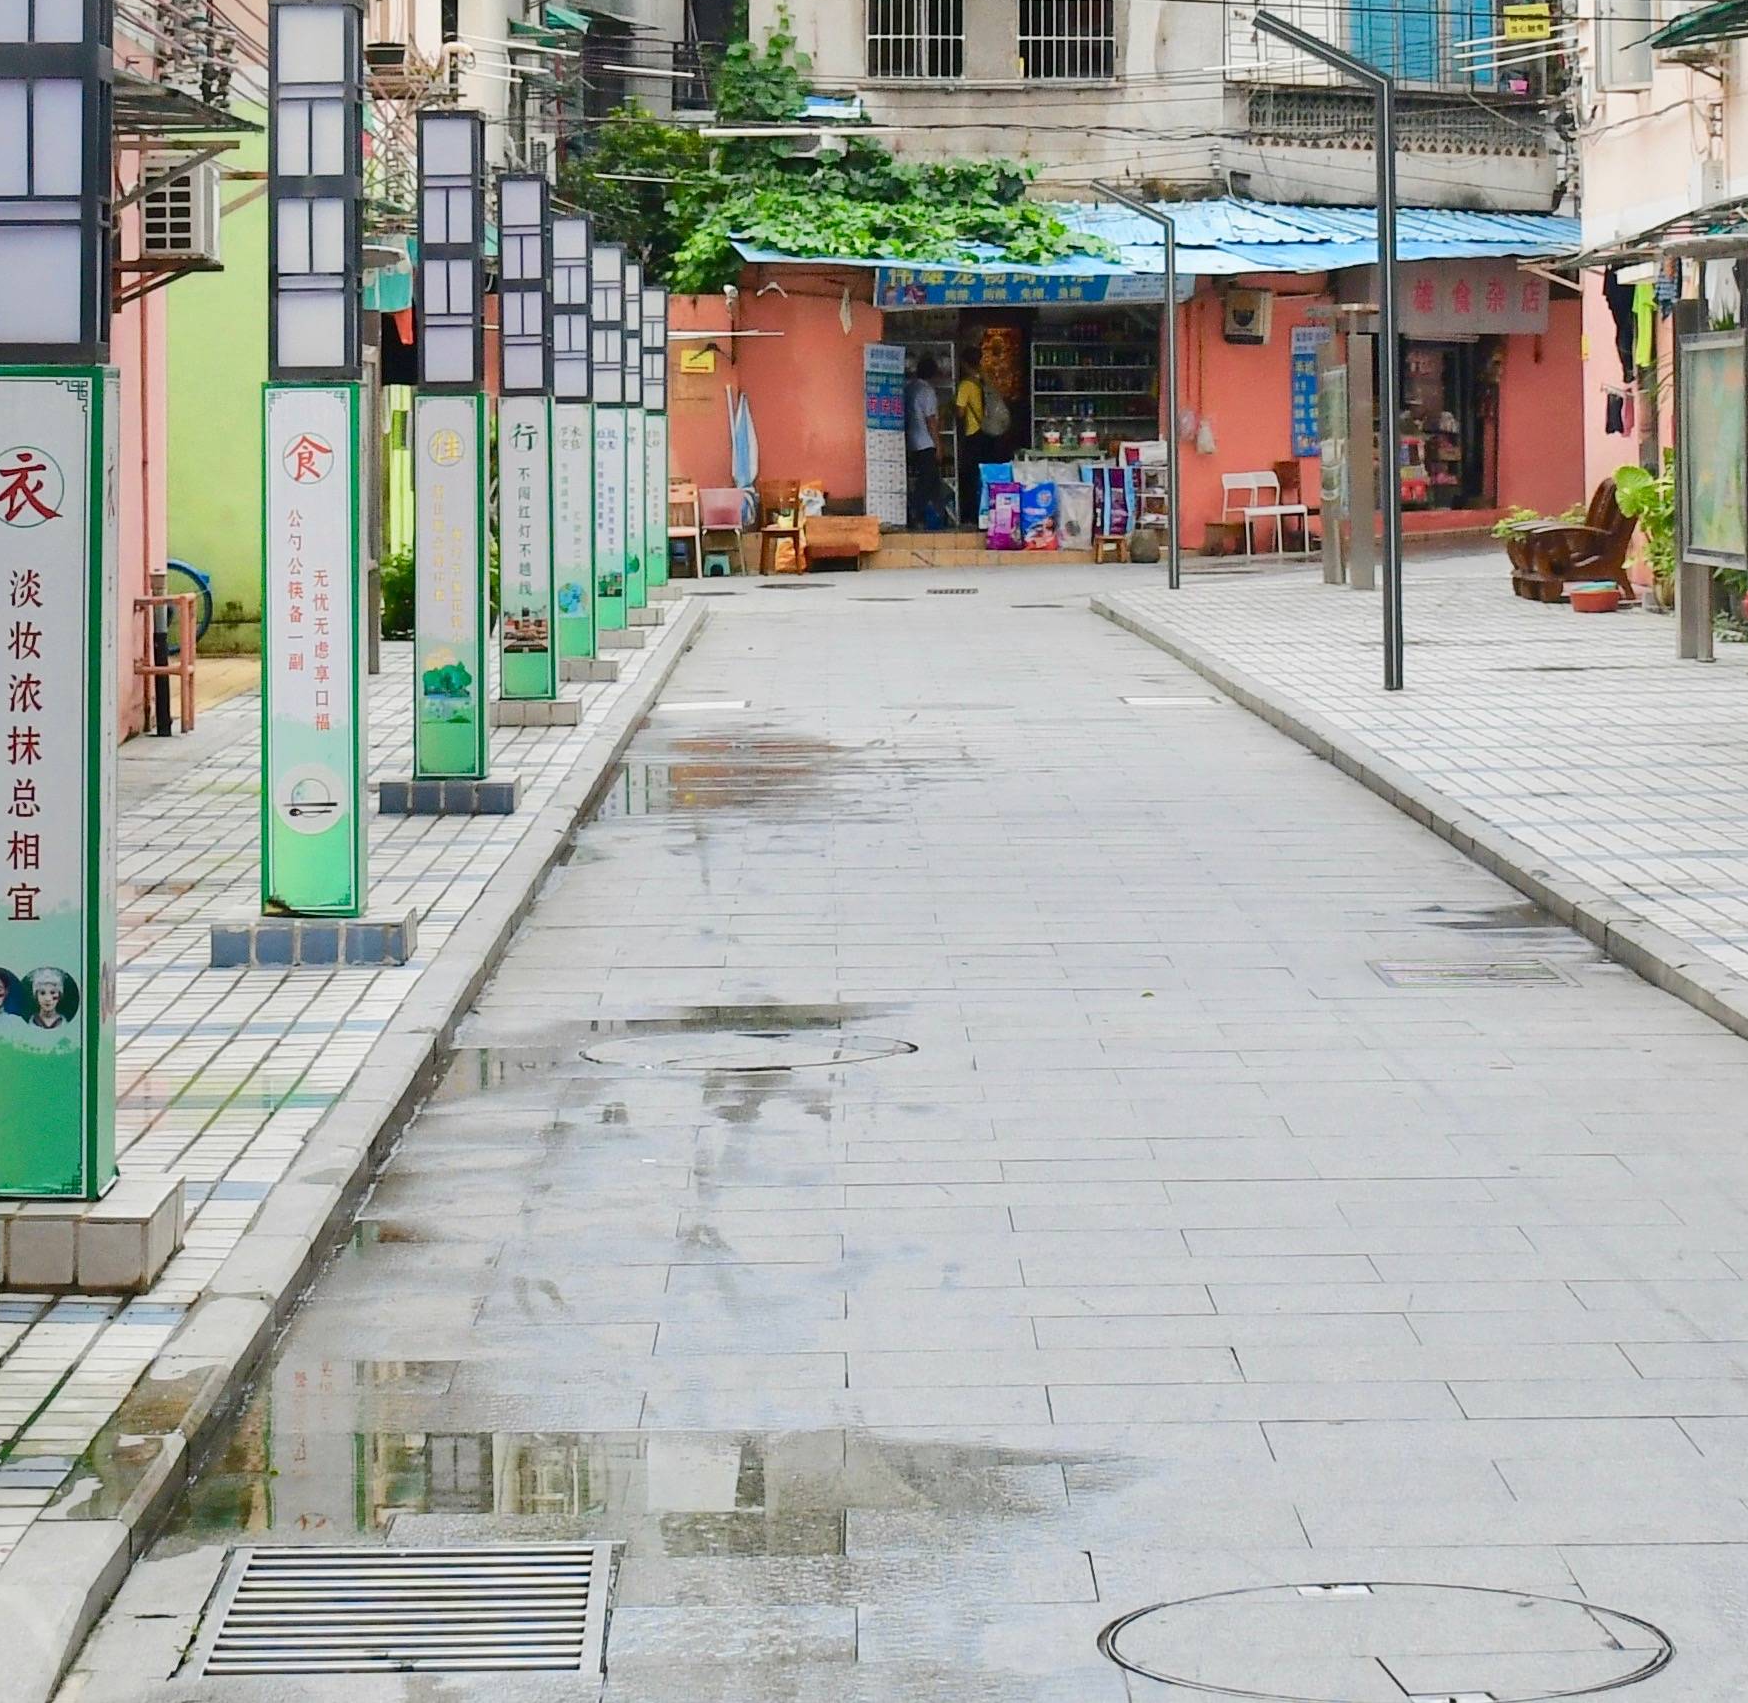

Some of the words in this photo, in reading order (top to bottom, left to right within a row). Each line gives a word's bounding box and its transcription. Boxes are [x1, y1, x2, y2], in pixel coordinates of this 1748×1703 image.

[283, 435, 332, 481] 食
[512, 423, 538, 451] 行
[288, 509, 304, 671] 公勺公筷备一副
[517, 467, 532, 596] 不闯红灯不越线
[313, 569, 330, 732] 无忧无虑享口福
[6, 569, 43, 922] 淡妆浓抹总相宜
